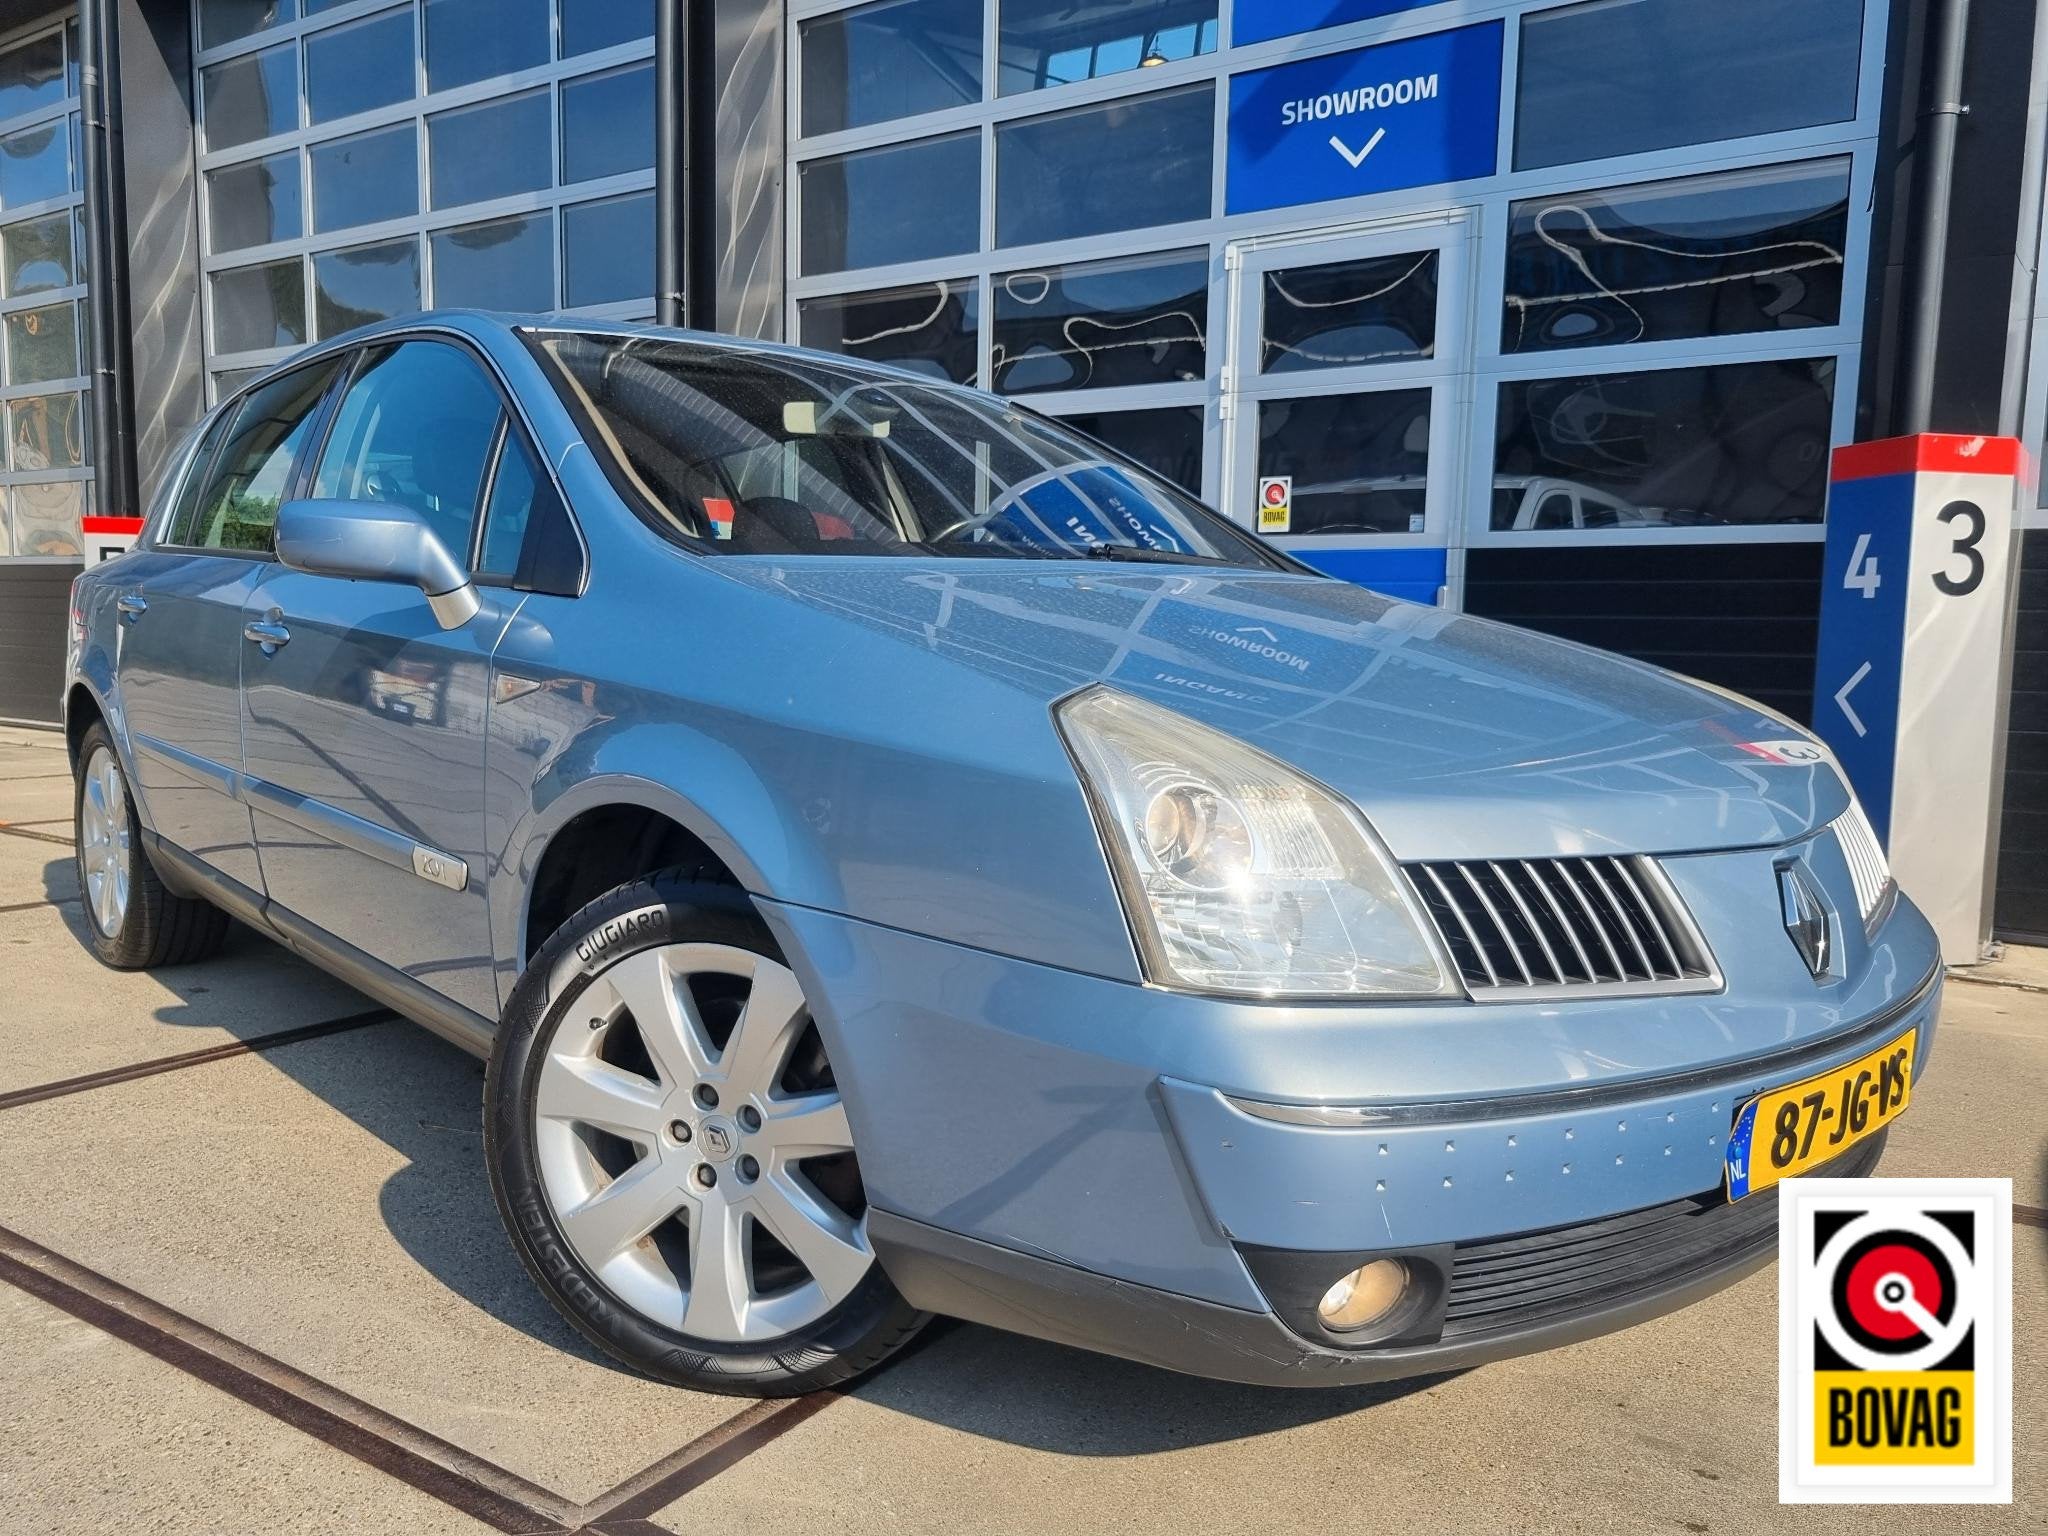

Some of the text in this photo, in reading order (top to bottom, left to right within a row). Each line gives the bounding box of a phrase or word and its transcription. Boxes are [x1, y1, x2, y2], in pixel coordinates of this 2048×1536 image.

[1282, 74, 1438, 125] SHOWROOM
[1263, 511, 1285, 523] BOVAG
[1843, 533, 1881, 598] 4
[1931, 500, 1986, 597] 3
[576, 909, 665, 962] GIUGIARO
[1770, 1047, 1908, 1169] 87-JG-VS
[1730, 1158, 1747, 1183] NL
